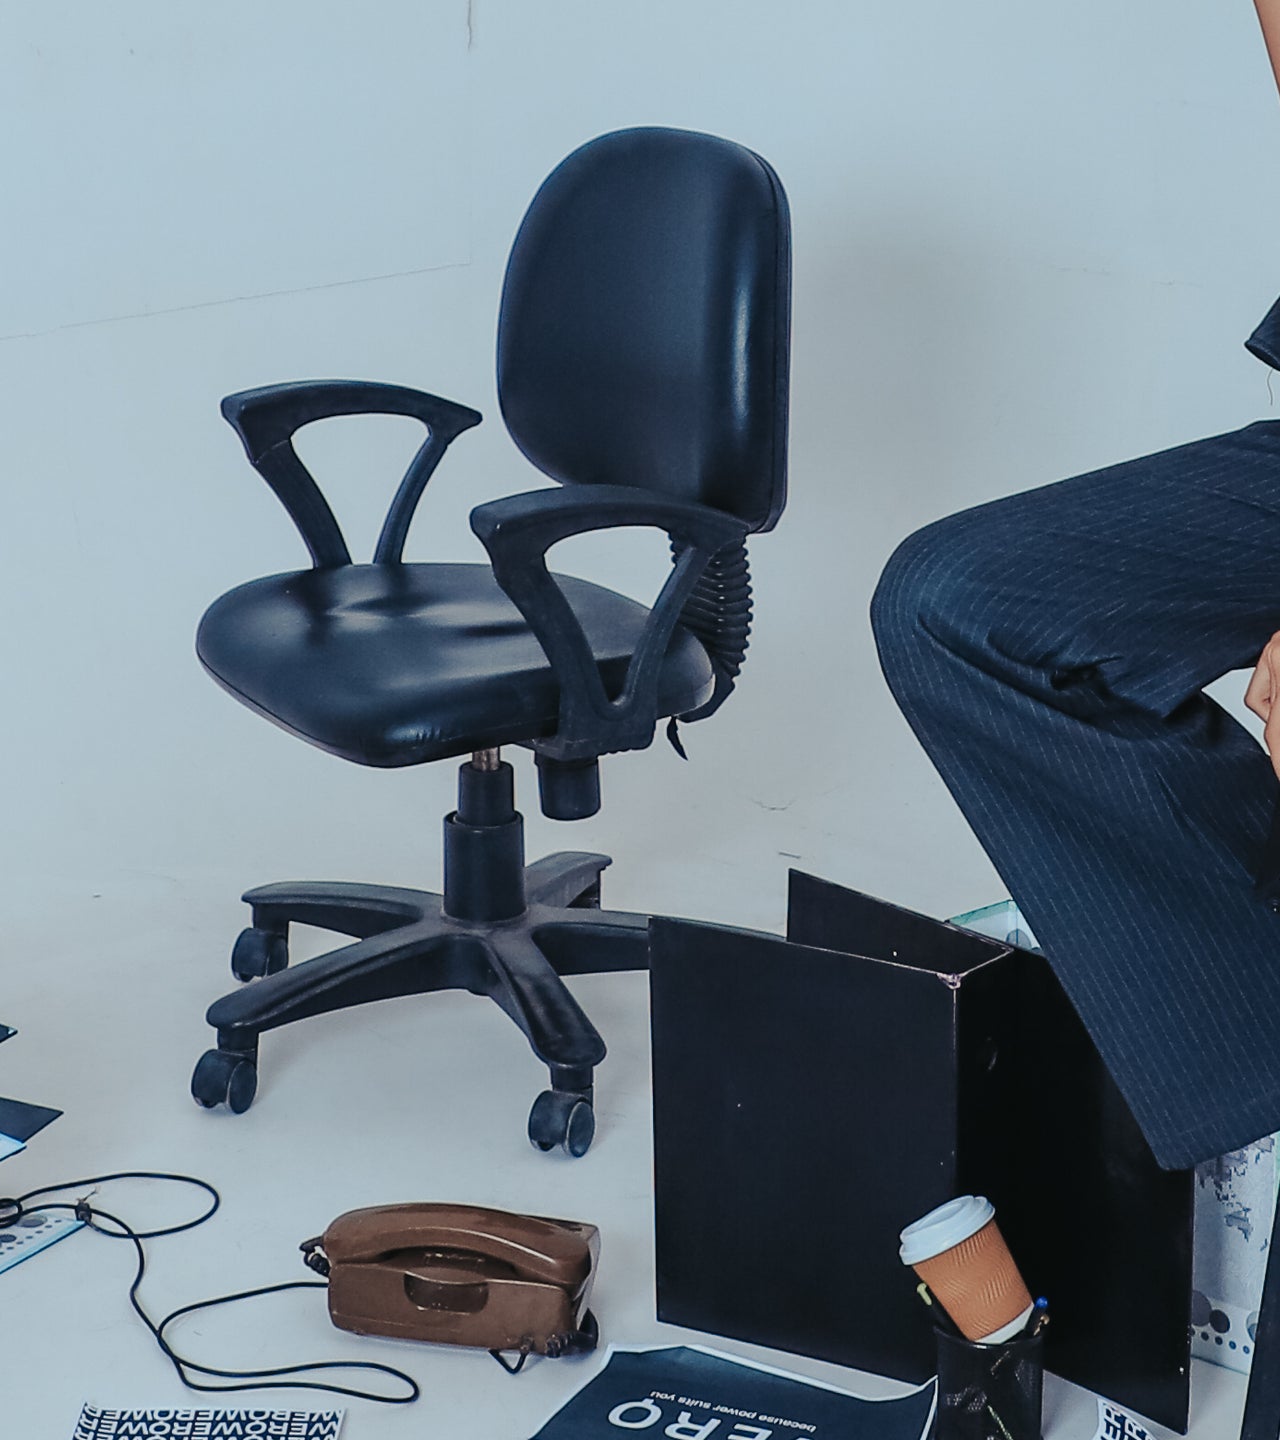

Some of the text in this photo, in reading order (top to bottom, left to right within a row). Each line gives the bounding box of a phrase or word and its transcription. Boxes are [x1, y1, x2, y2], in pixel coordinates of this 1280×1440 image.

[649, 1390, 817, 1432] because power suits you
